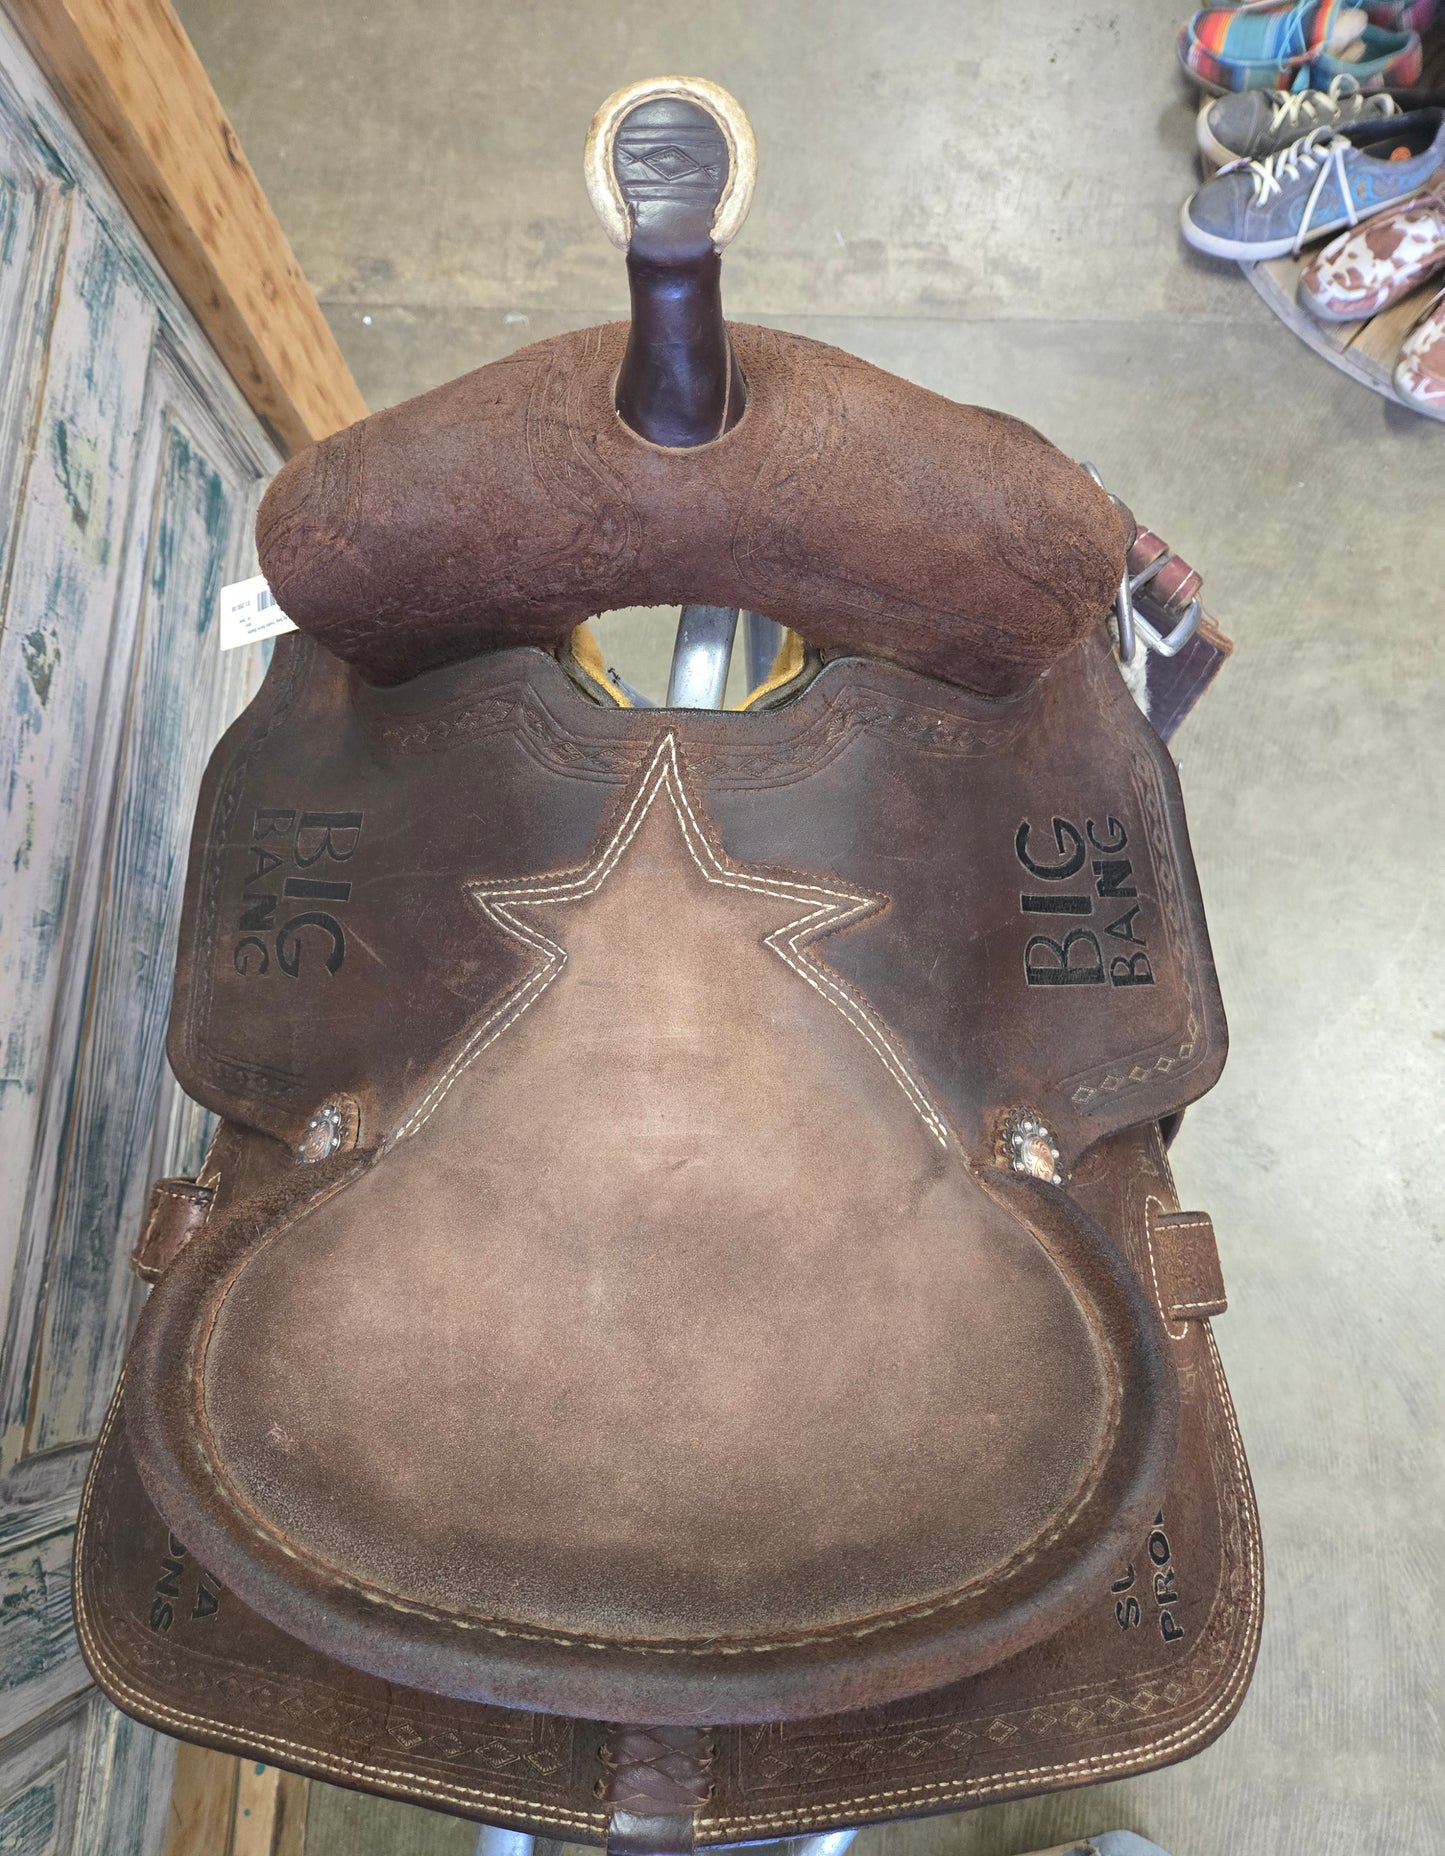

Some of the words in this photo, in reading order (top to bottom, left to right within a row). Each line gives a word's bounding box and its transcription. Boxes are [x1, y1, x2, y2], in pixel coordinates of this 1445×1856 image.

[276, 811, 364, 979] BIG
[1014, 815, 1106, 986] BIG
[1085, 815, 1156, 987] BANG
[1148, 1507, 1185, 1643] PRO
